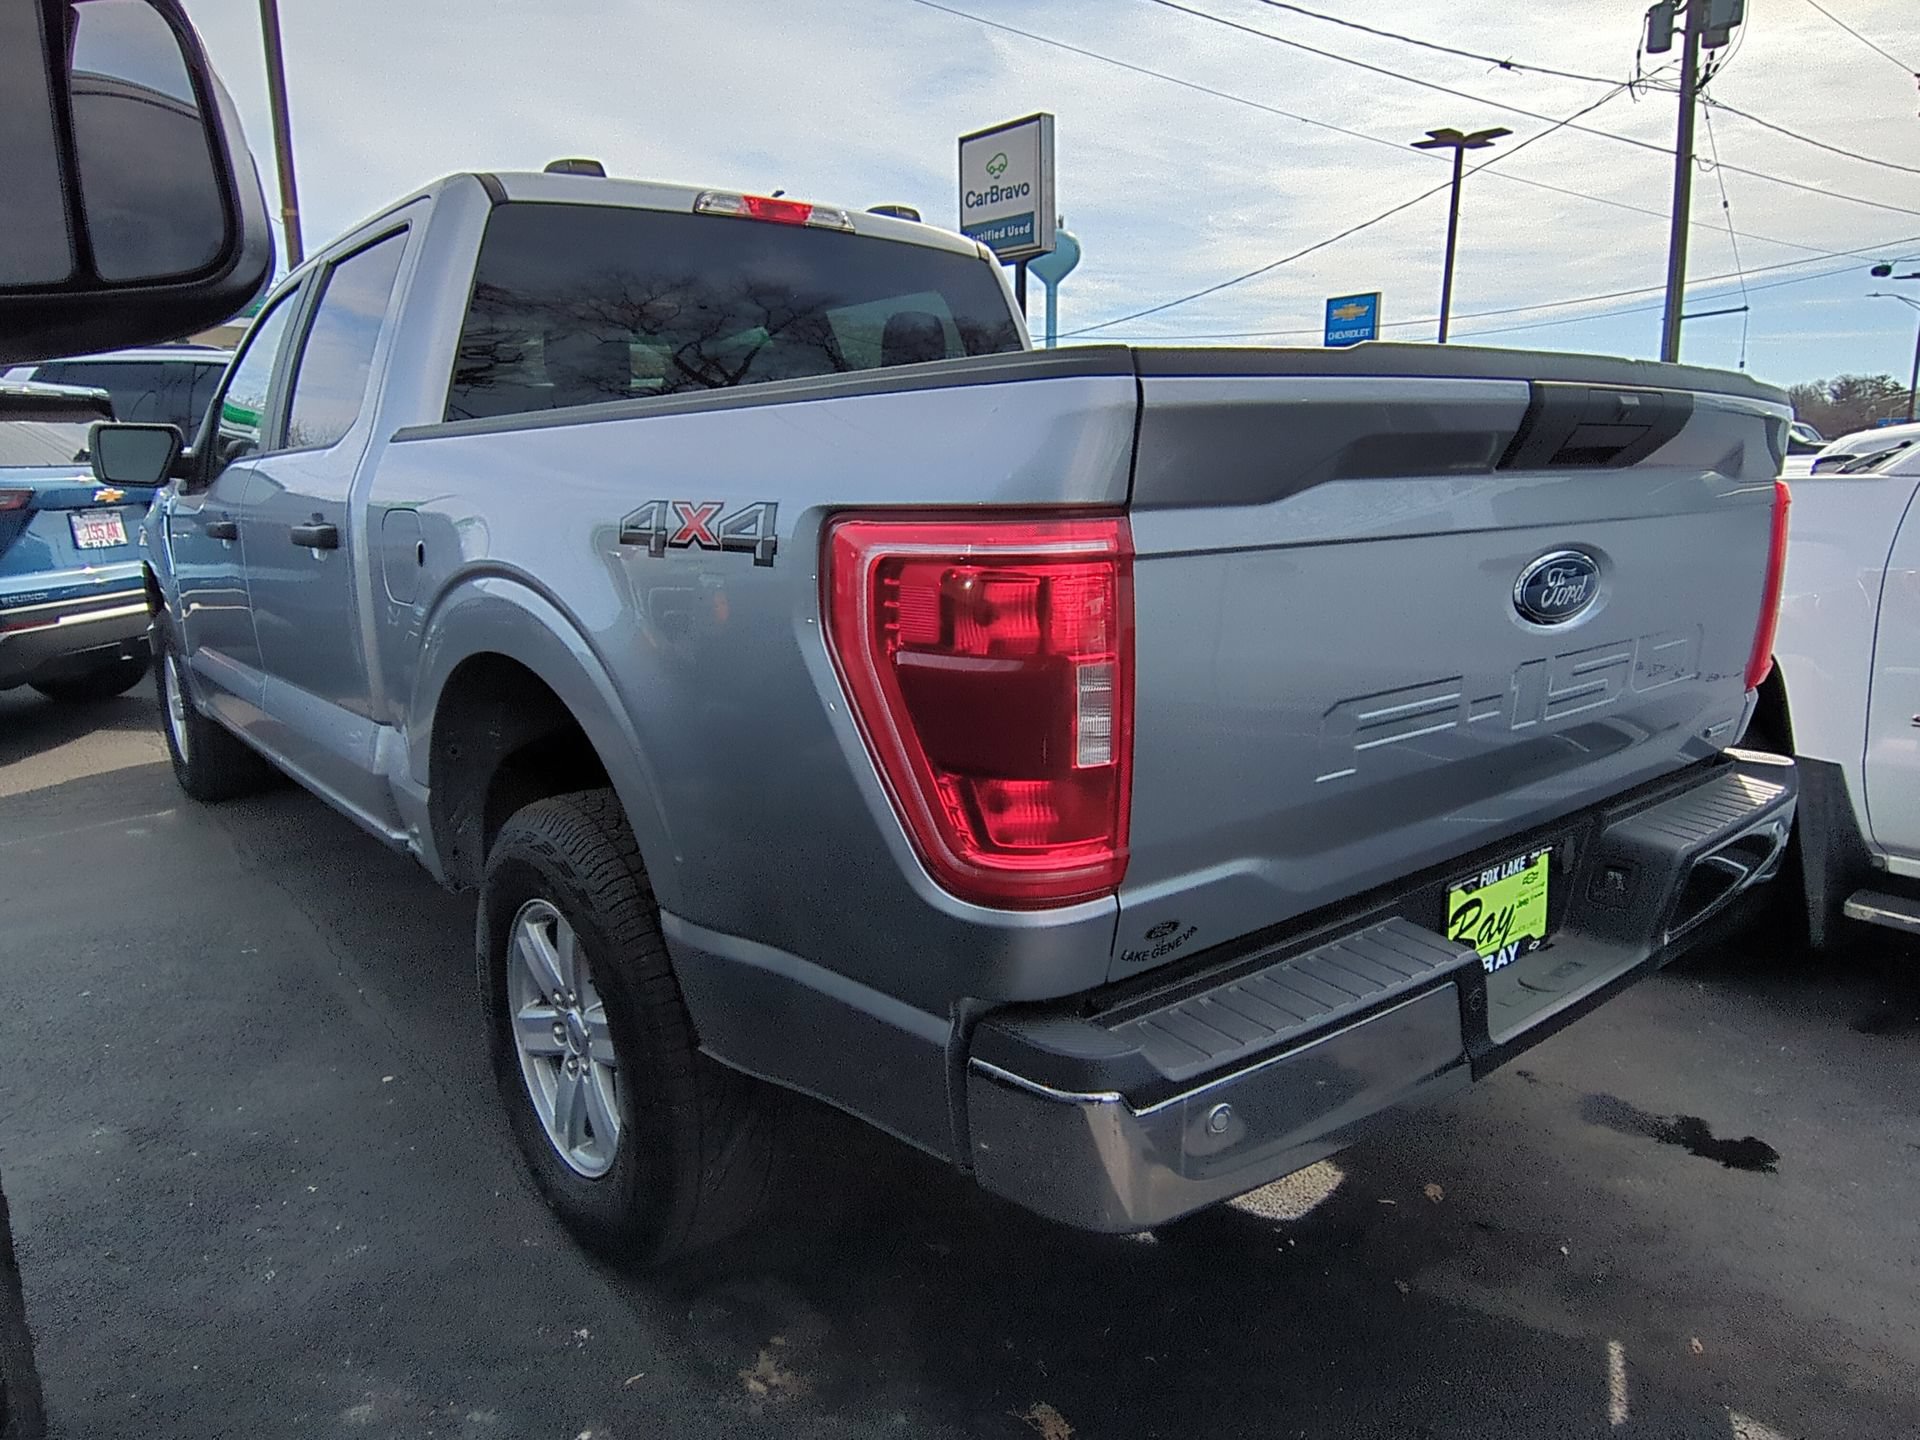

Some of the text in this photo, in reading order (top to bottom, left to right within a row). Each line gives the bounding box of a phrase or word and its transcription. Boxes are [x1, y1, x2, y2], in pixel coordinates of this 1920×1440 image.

[965, 182, 1030, 208] CarBravo
[1007, 222, 1031, 237] Used
[1541, 567, 1588, 608] Ford
[1314, 623, 1704, 783] F-150
[1480, 866, 1500, 888] FOX
[1501, 855, 1527, 880] LAKE
[1449, 898, 1516, 951] Ray
[1121, 949, 1150, 962] LAKE
[1151, 926, 1198, 959] GENEVA
[1481, 941, 1520, 973] RAY
